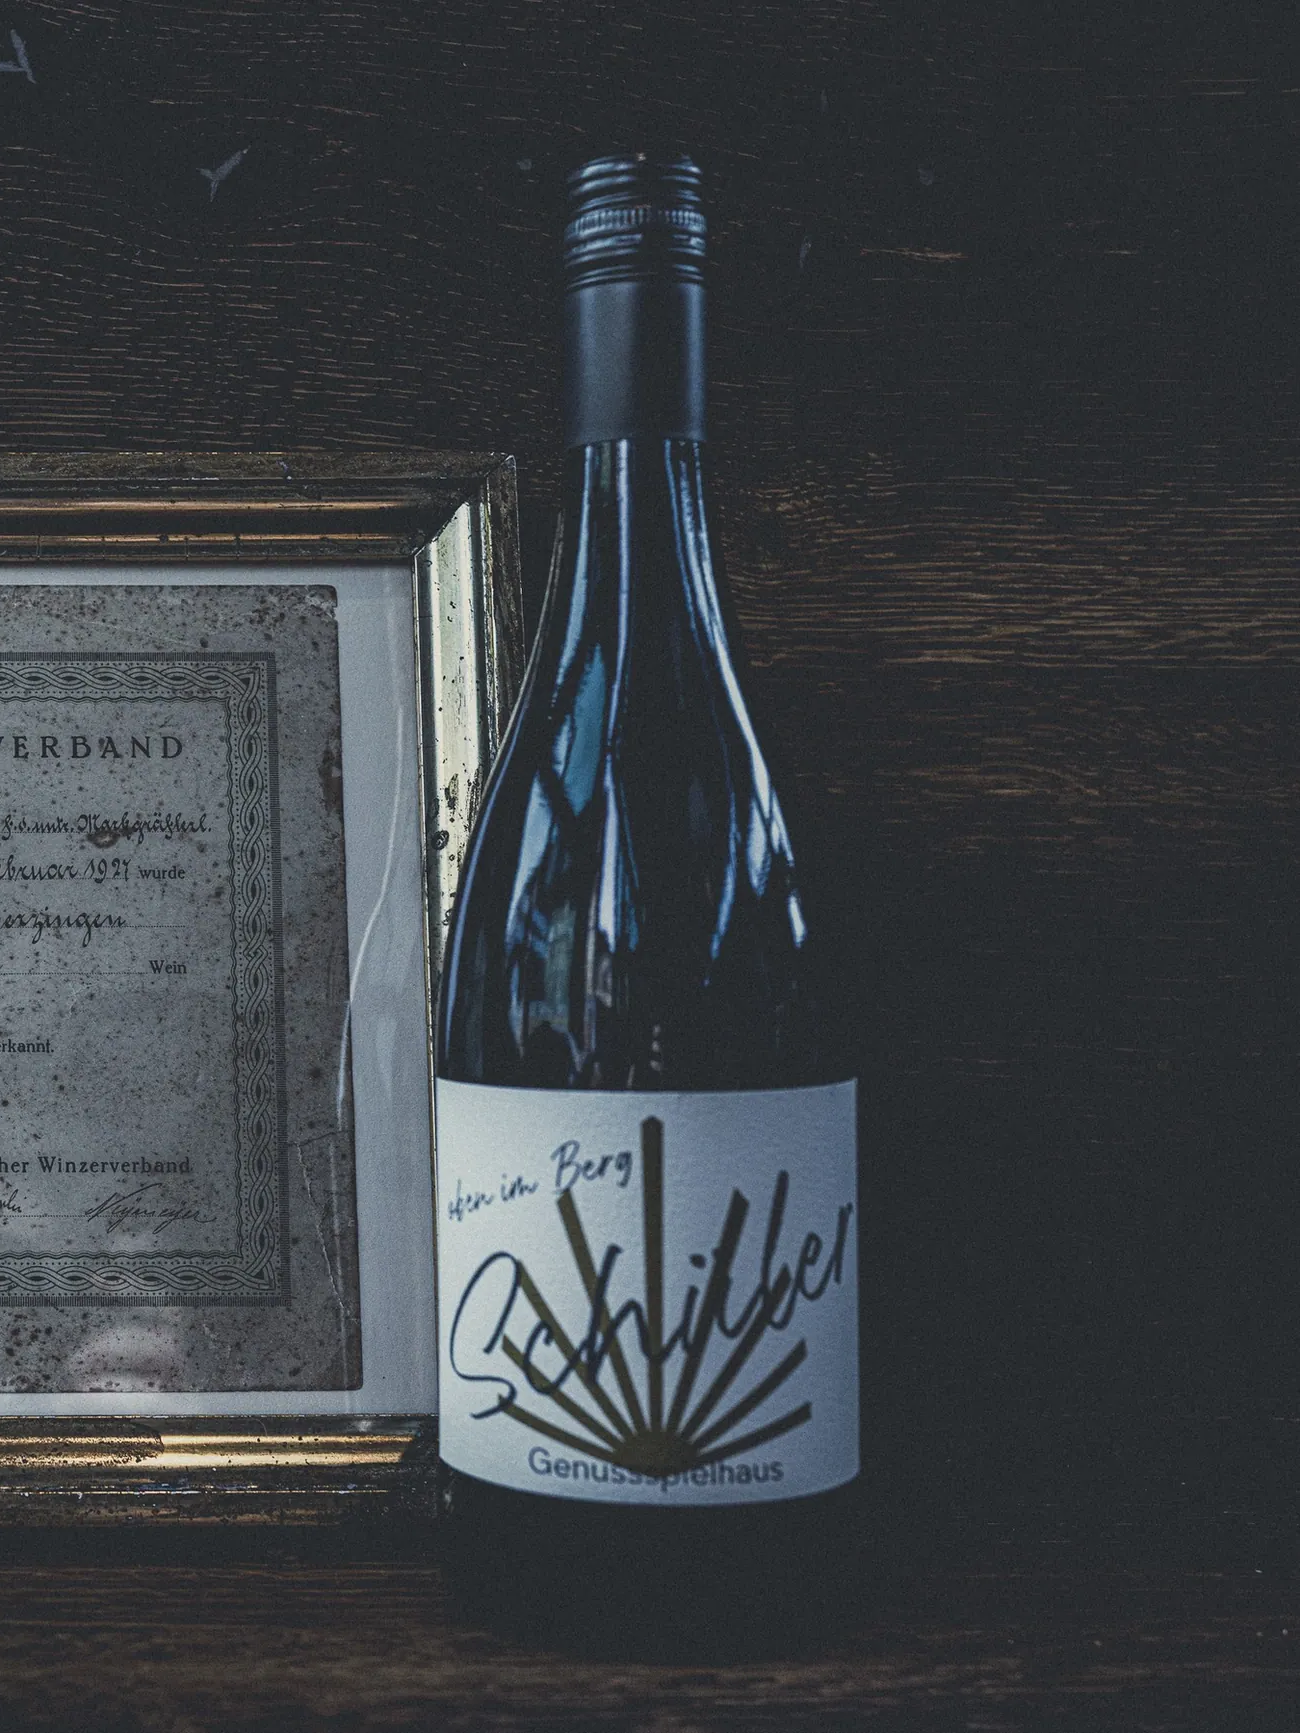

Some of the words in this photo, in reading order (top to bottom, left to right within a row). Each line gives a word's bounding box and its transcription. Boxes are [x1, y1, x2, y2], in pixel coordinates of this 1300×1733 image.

[137, 865, 186, 881] wurde
[148, 958, 187, 975] Wein
[37, 1156, 190, 1174] Winzerverband
[550, 1139, 633, 1194] Berg
